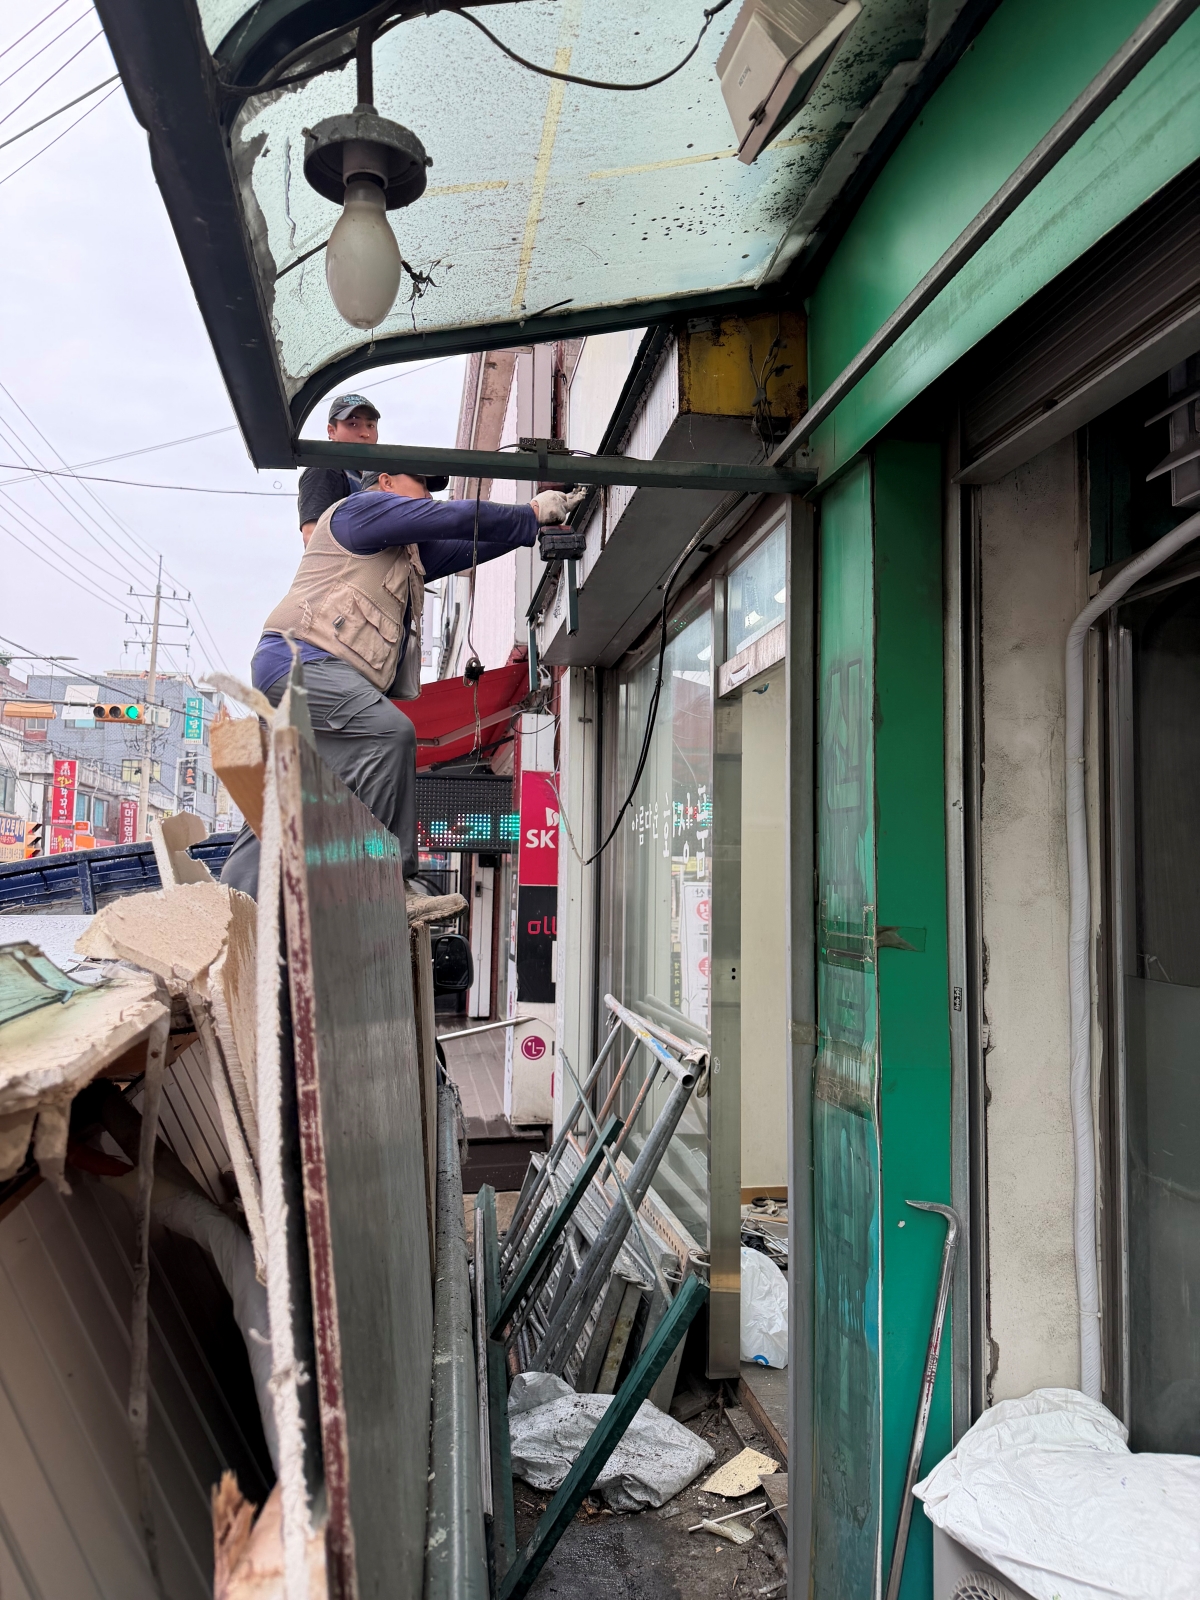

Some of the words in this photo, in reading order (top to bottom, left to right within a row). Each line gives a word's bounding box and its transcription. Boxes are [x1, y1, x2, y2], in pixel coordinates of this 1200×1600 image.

[525, 829, 556, 848] SK
[631, 801, 659, 846] 아름다운
[662, 784, 709, 880] 화장품
